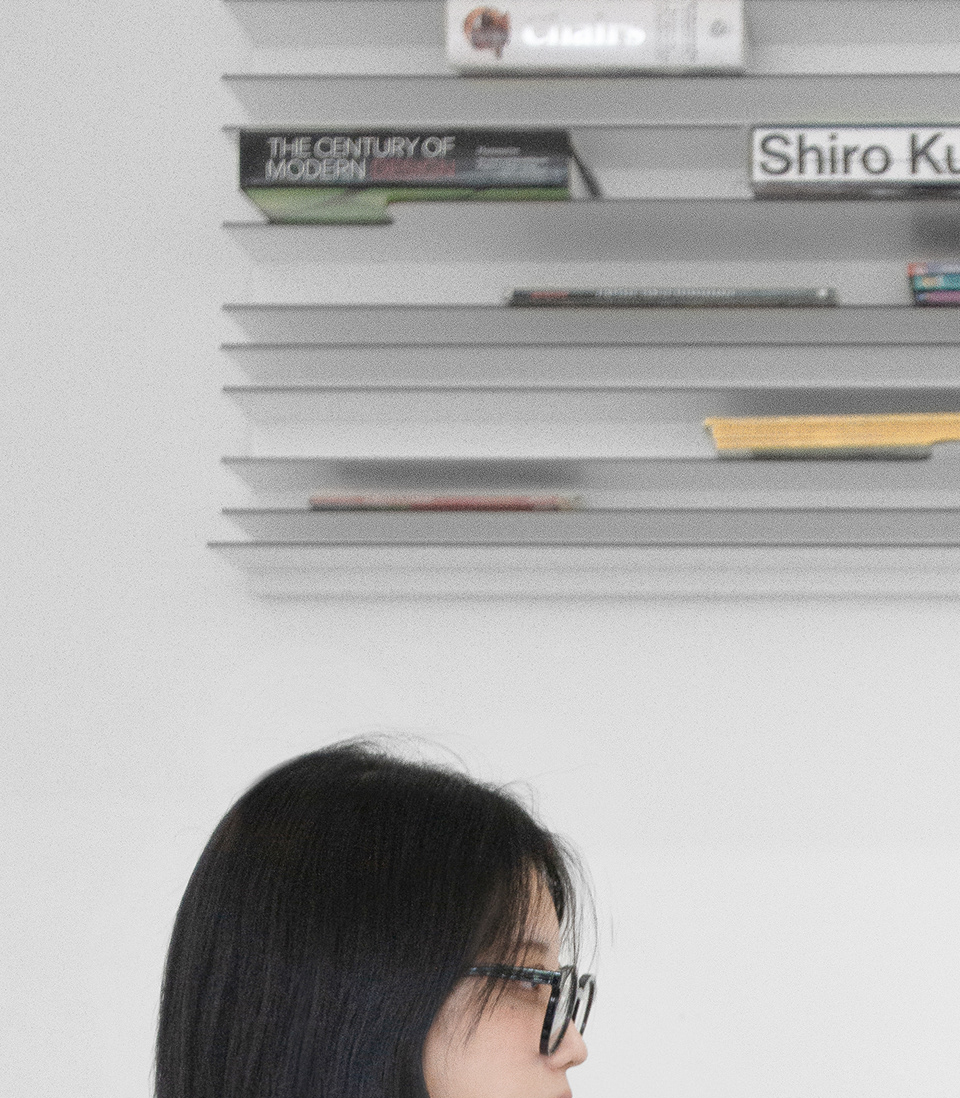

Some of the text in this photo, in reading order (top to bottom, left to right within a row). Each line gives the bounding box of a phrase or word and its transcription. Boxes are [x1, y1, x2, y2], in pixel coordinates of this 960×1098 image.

[265, 136, 313, 159] THE
[313, 136, 421, 159] CENTURY
[421, 136, 456, 159] OF
[759, 133, 891, 176] Shiro
[265, 158, 367, 181] MODERN
